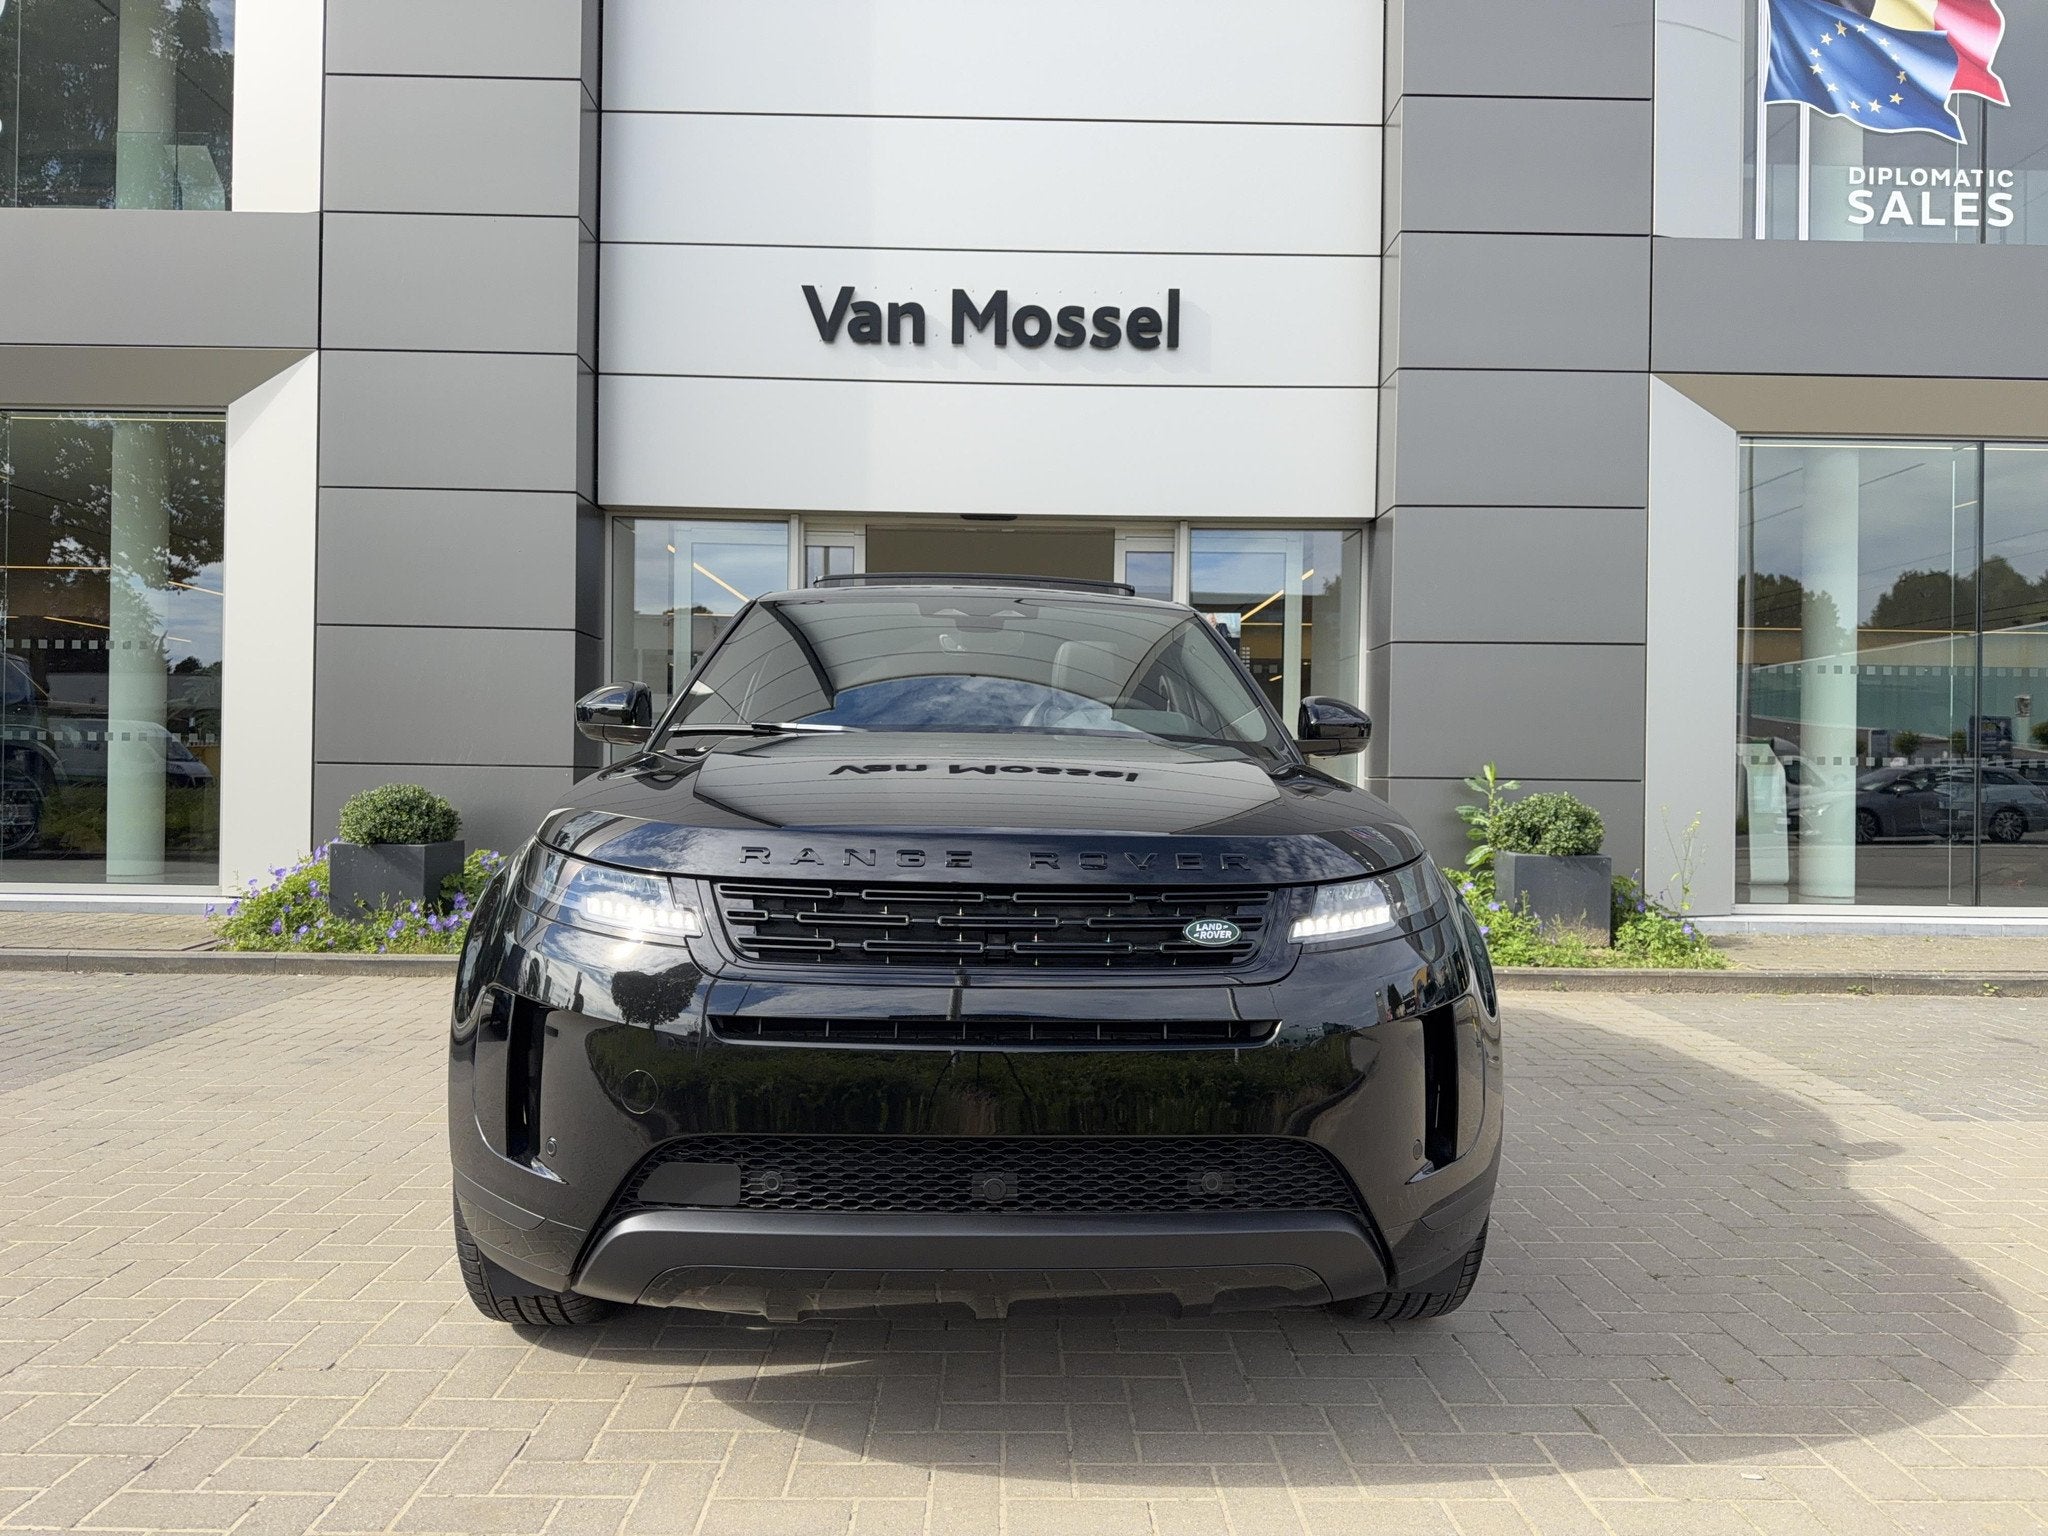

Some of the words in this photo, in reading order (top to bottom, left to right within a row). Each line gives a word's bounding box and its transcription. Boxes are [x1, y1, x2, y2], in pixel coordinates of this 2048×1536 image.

[1849, 167, 2014, 188] DIPLOMATIC
[1848, 190, 2014, 227] SALES
[801, 285, 925, 344] Van
[951, 288, 1180, 349] Mossel
[739, 846, 973, 868] RANGE
[1029, 850, 1251, 870] ROVER
[1196, 923, 1223, 931] LAND
[1200, 931, 1232, 939] ROVER
